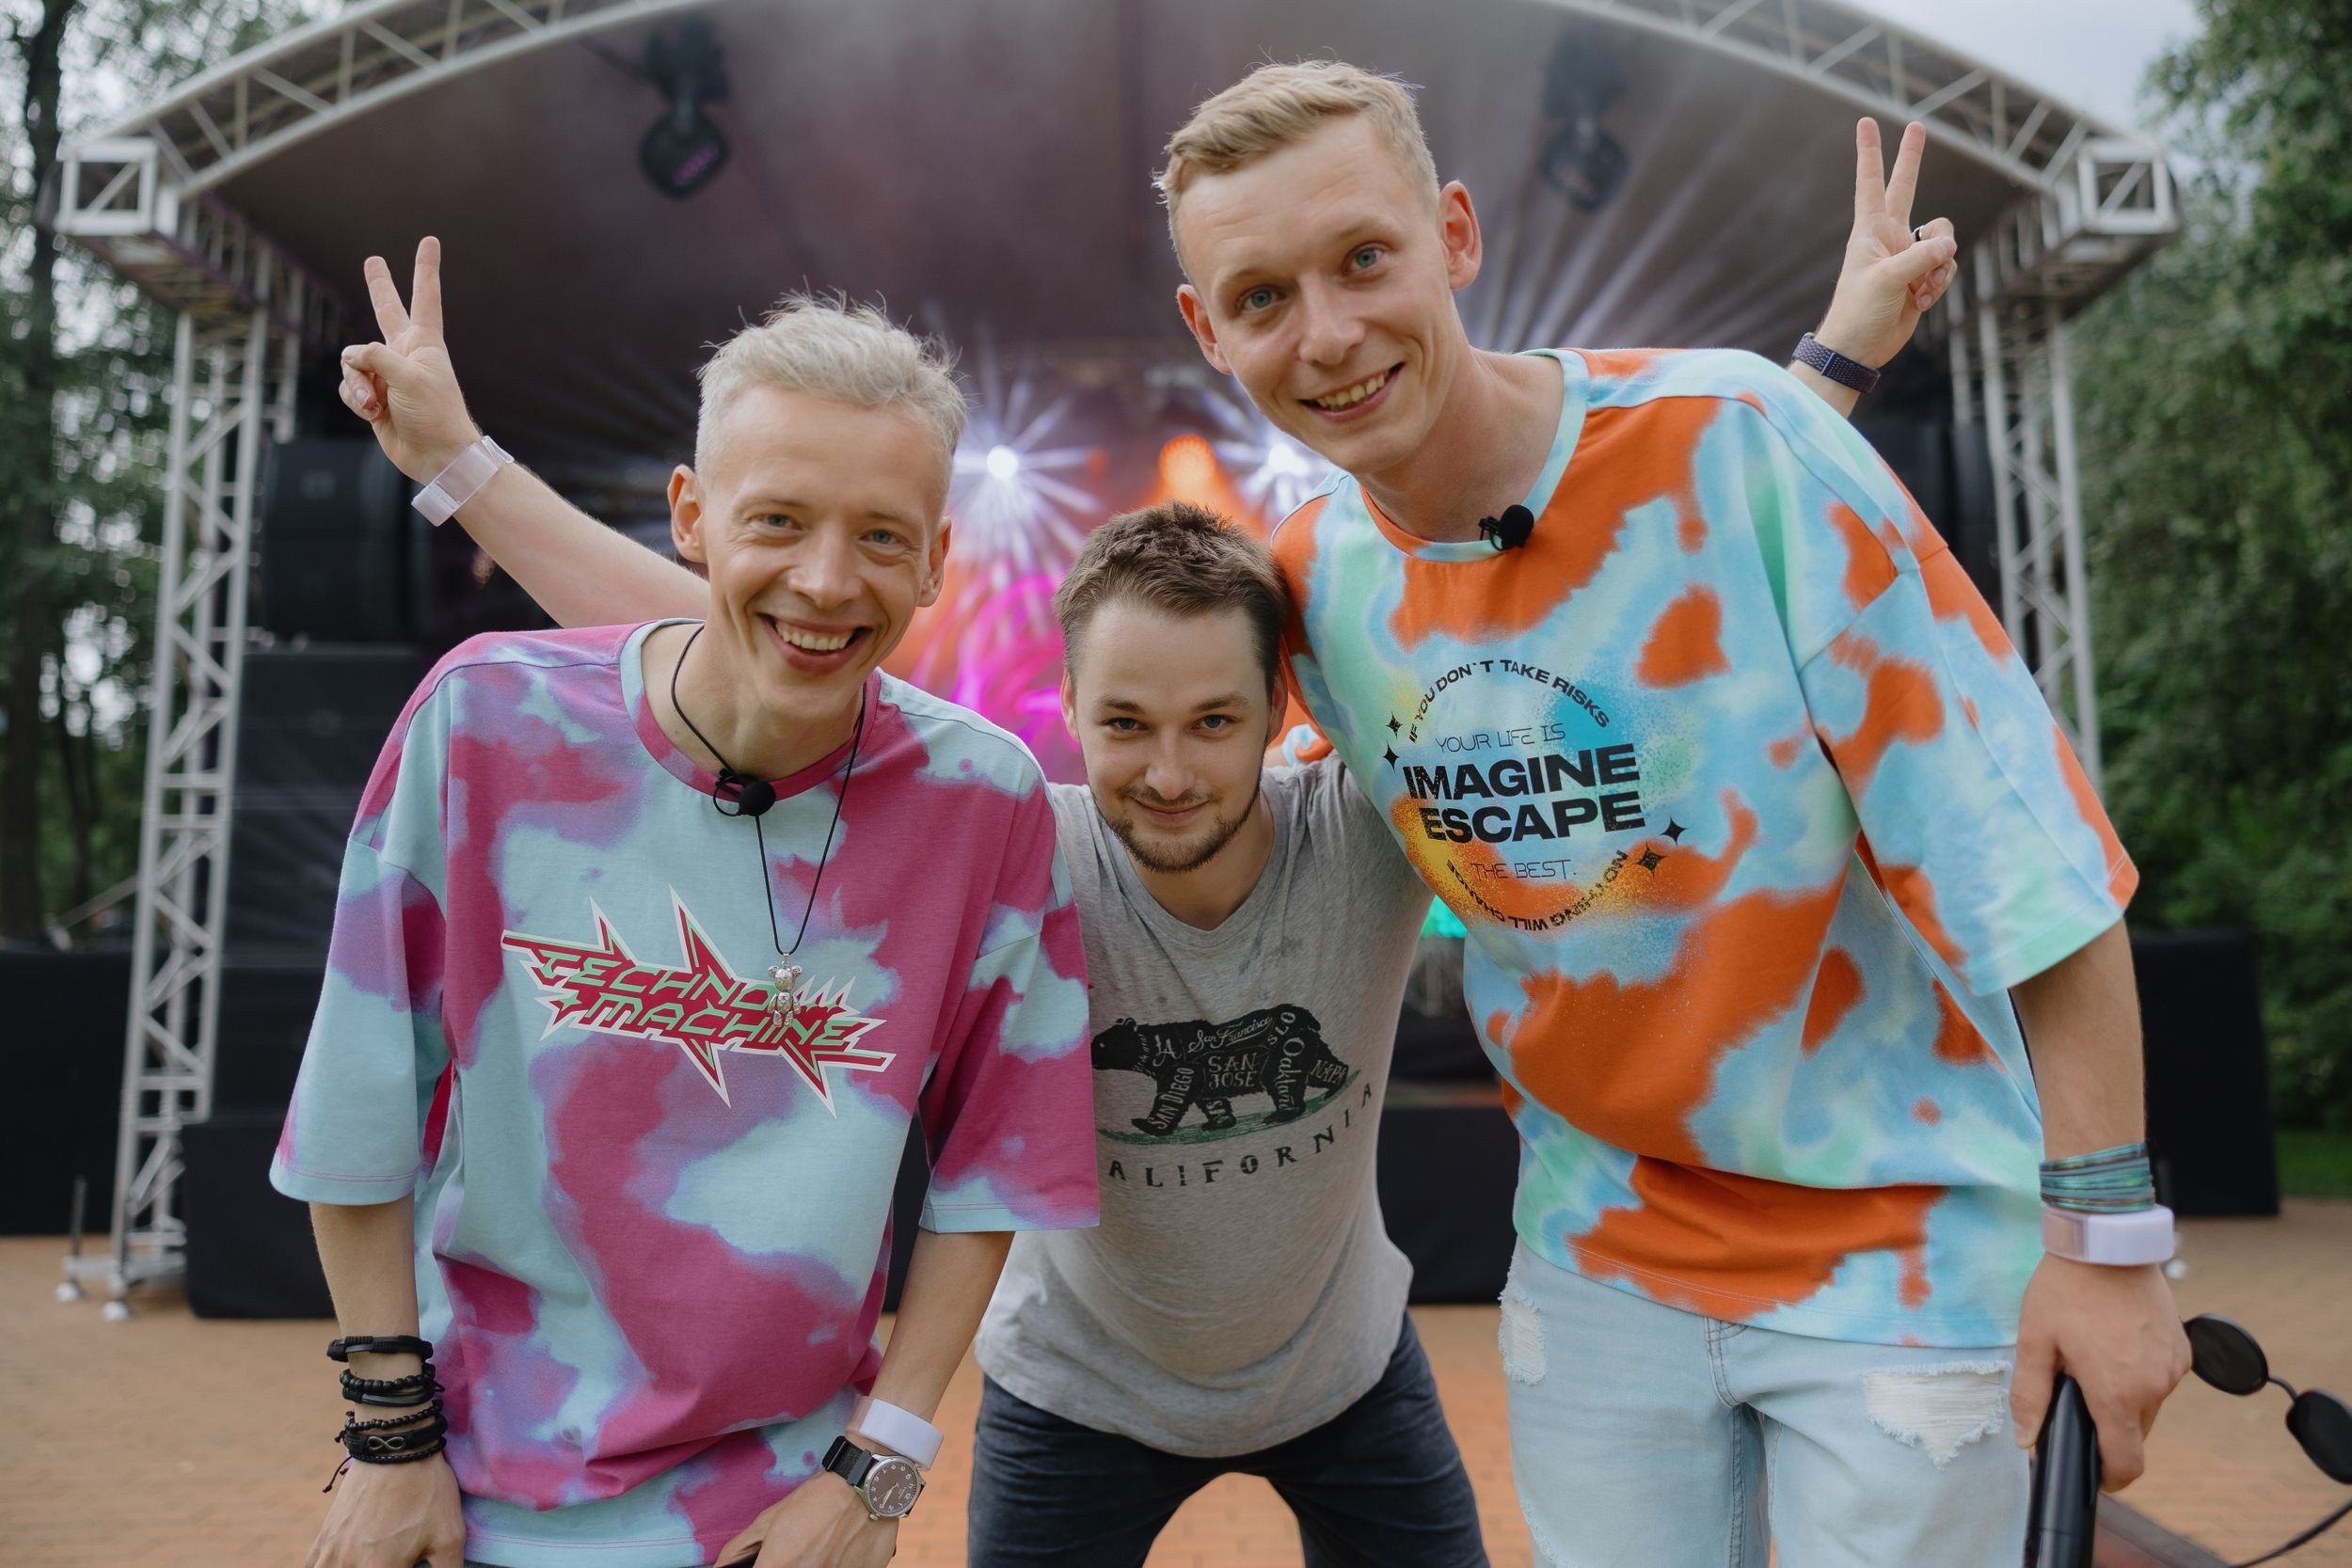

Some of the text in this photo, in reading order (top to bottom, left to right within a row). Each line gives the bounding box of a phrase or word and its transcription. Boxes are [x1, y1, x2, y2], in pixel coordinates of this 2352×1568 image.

[1409, 723, 1419, 744] IF
[1414, 687, 1436, 722] YOU
[1500, 659, 1550, 684] TAKE
[1552, 676, 1610, 728] RISKS
[1435, 733, 1491, 752] YOUR
[1540, 722, 1565, 742] IS
[1402, 743, 1641, 800] IMAGINE
[1418, 790, 1645, 844] ESCAPE
[1447, 849, 1629, 931] NOTHING WILL CHANGE
[1470, 863, 1508, 880] THE
[538, 948, 783, 1011] TECHNO
[583, 991, 863, 1046] MACHINE
[1187, 1030, 1217, 1053] San
[1208, 1053, 1258, 1073] SAN
[1209, 1070, 1258, 1090] JOSE
[1148, 1067, 1195, 1130] SAN DIEGO
[1108, 1083, 1373, 1187] ALIFORNIA
